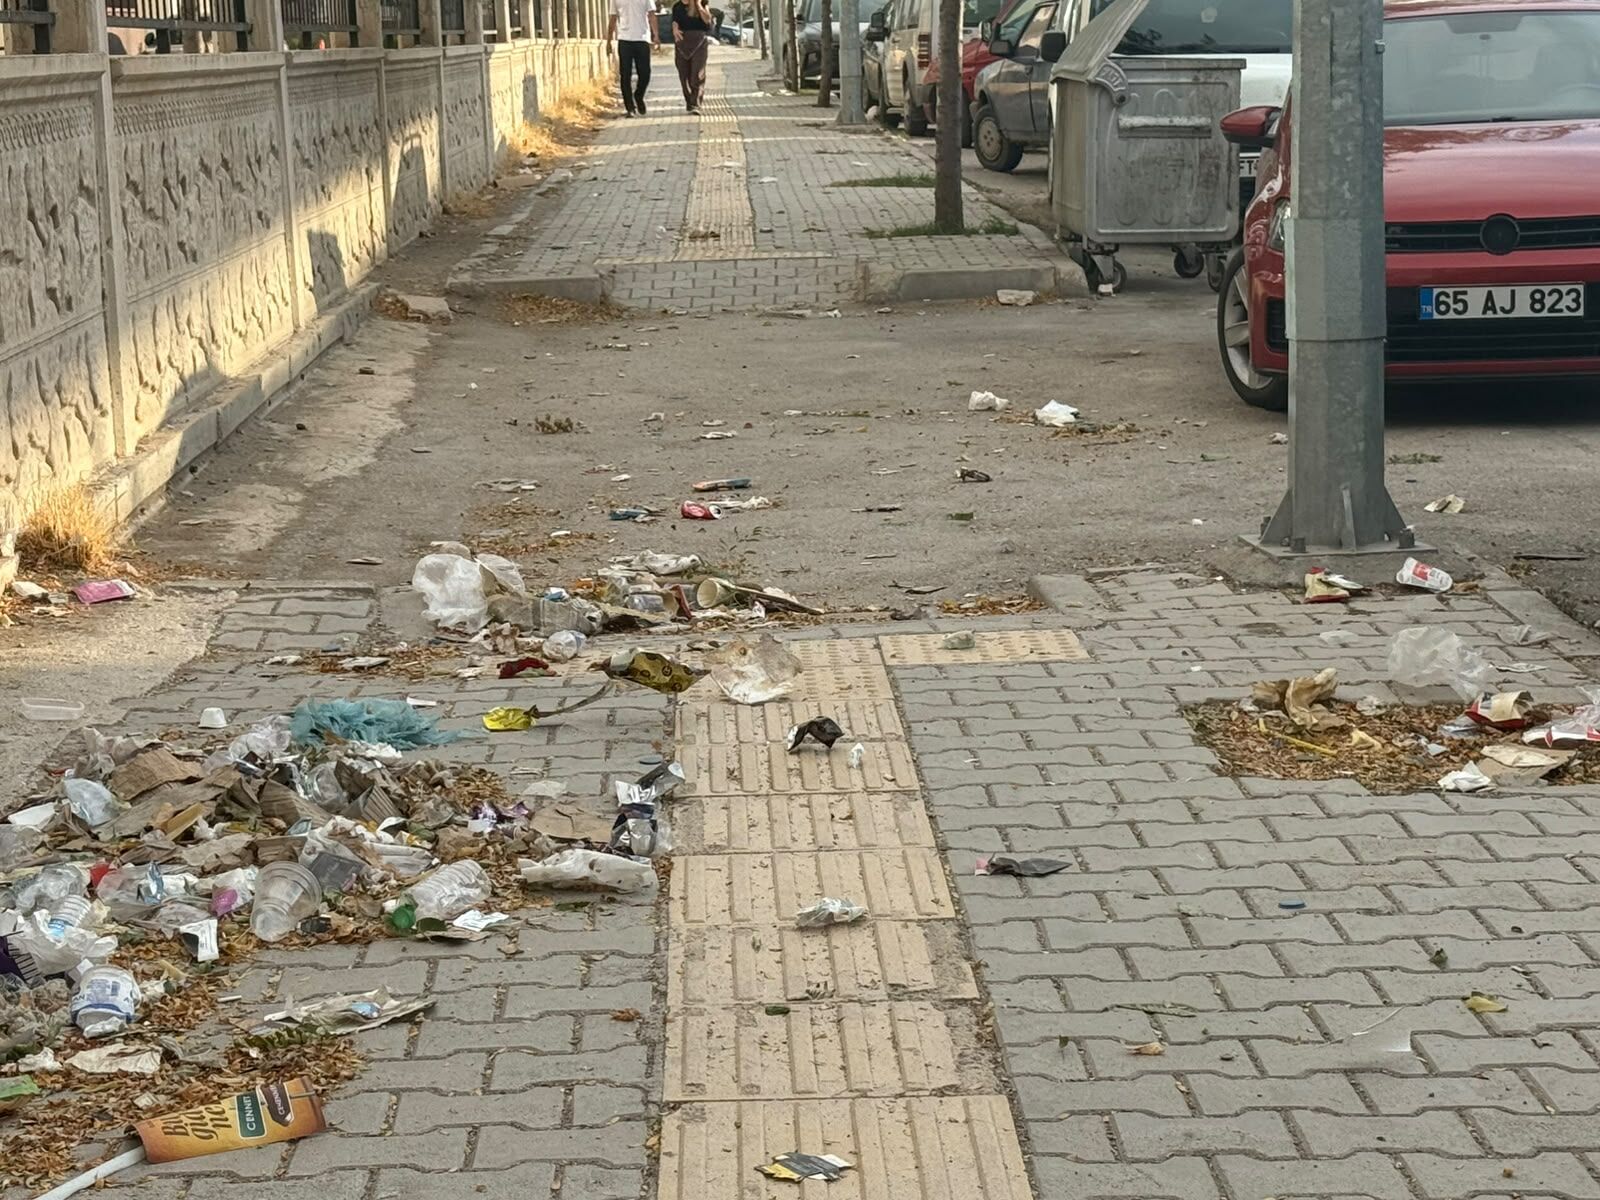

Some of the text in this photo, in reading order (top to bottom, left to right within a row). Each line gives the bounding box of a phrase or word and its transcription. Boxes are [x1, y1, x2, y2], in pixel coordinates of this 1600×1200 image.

[1421, 305, 1433, 313] TR
[1434, 287, 1582, 316] 65 AJ 823
[242, 1095, 257, 1131] CENNET
